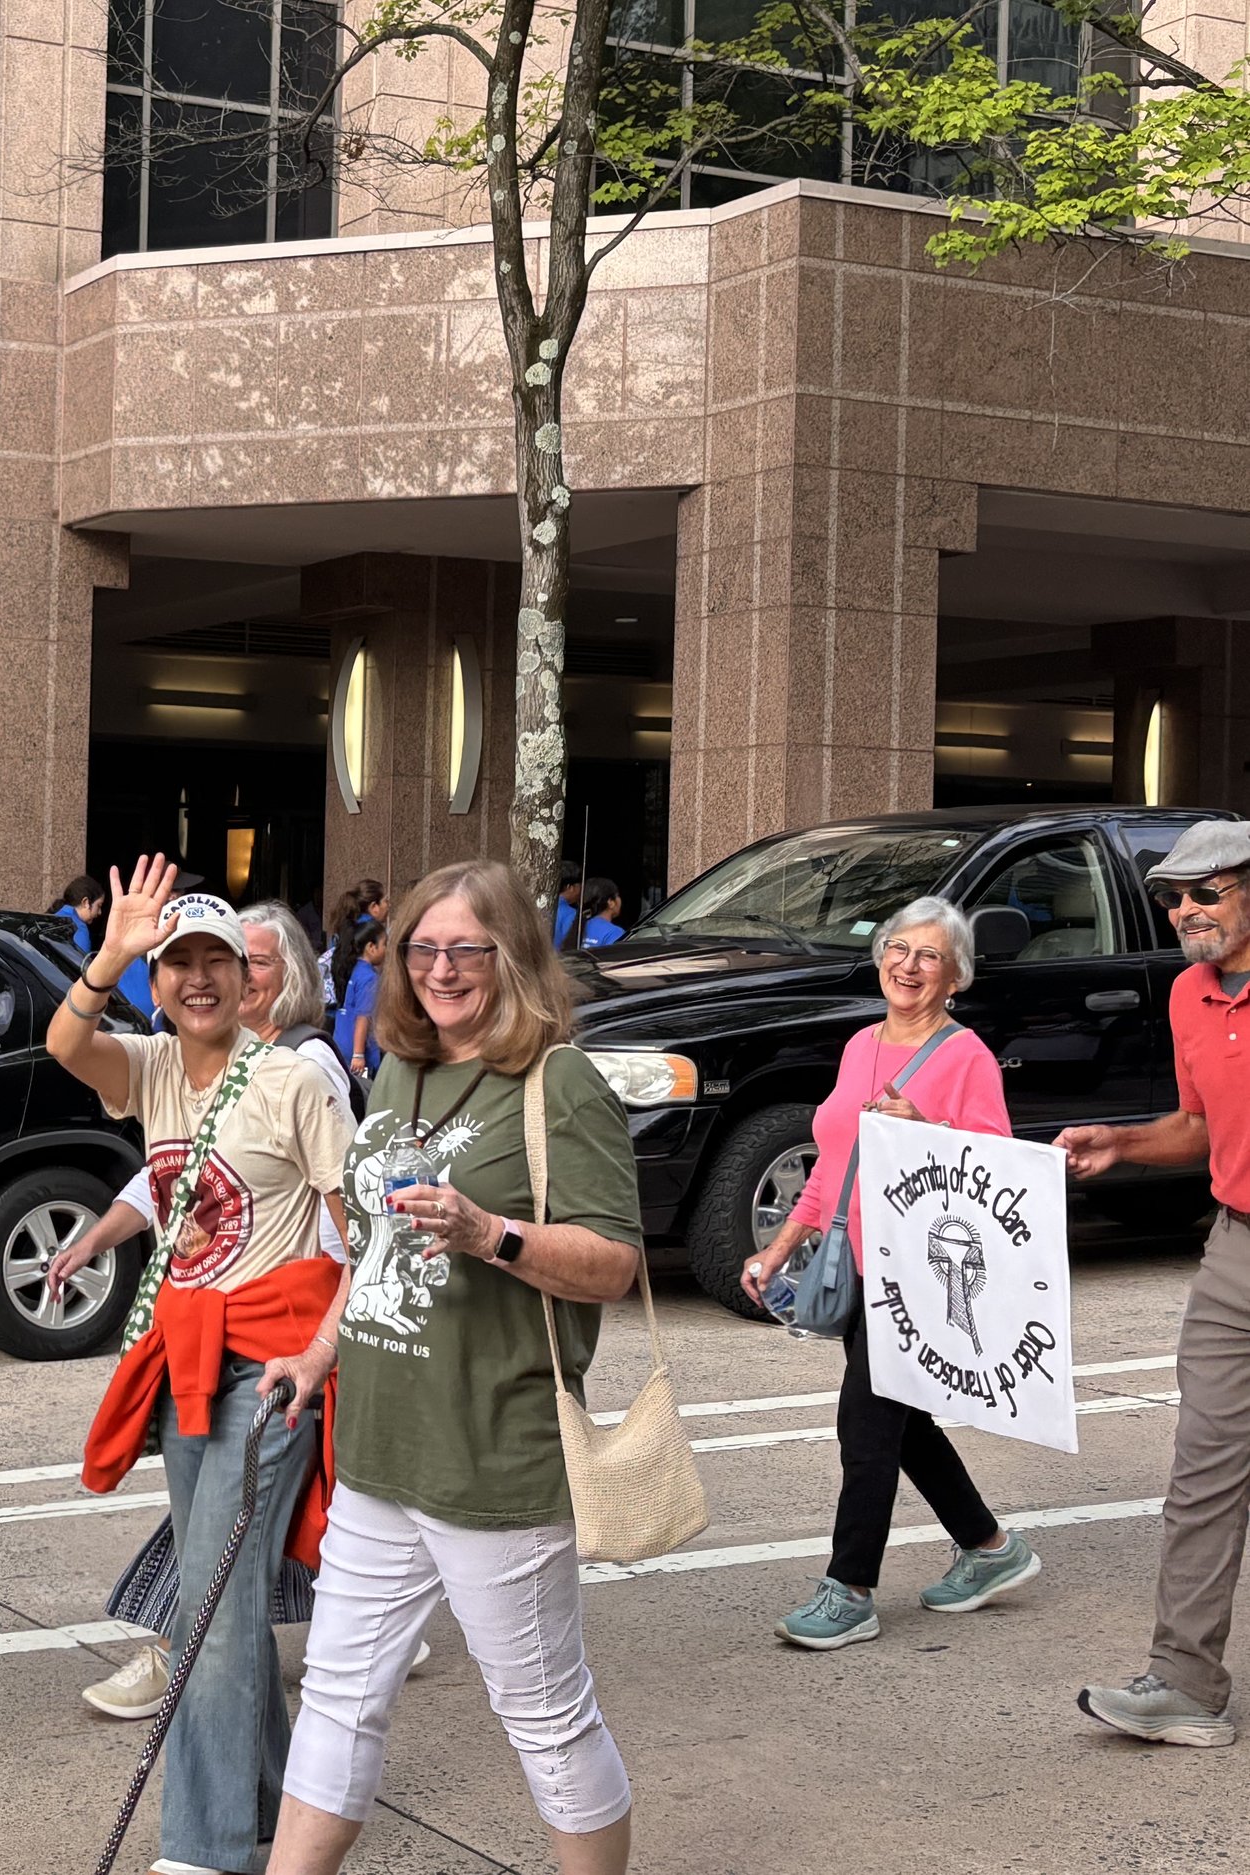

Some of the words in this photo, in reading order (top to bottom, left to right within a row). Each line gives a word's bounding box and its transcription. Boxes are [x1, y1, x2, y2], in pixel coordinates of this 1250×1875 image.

[163, 896, 226, 920] CAROLINA
[883, 1151, 949, 1218] Fraternity
[950, 1145, 973, 1194] of
[967, 1165, 992, 1209] St.
[992, 1187, 1032, 1248] Clare
[357, 1331, 380, 1347] PRAY
[383, 1338, 407, 1354] FOR
[413, 1344, 430, 1358] US
[870, 1277, 920, 1354] Secular
[918, 1343, 998, 1409] Franciscan
[1012, 1320, 1056, 1384] Order
[995, 1363, 1018, 1418] of
